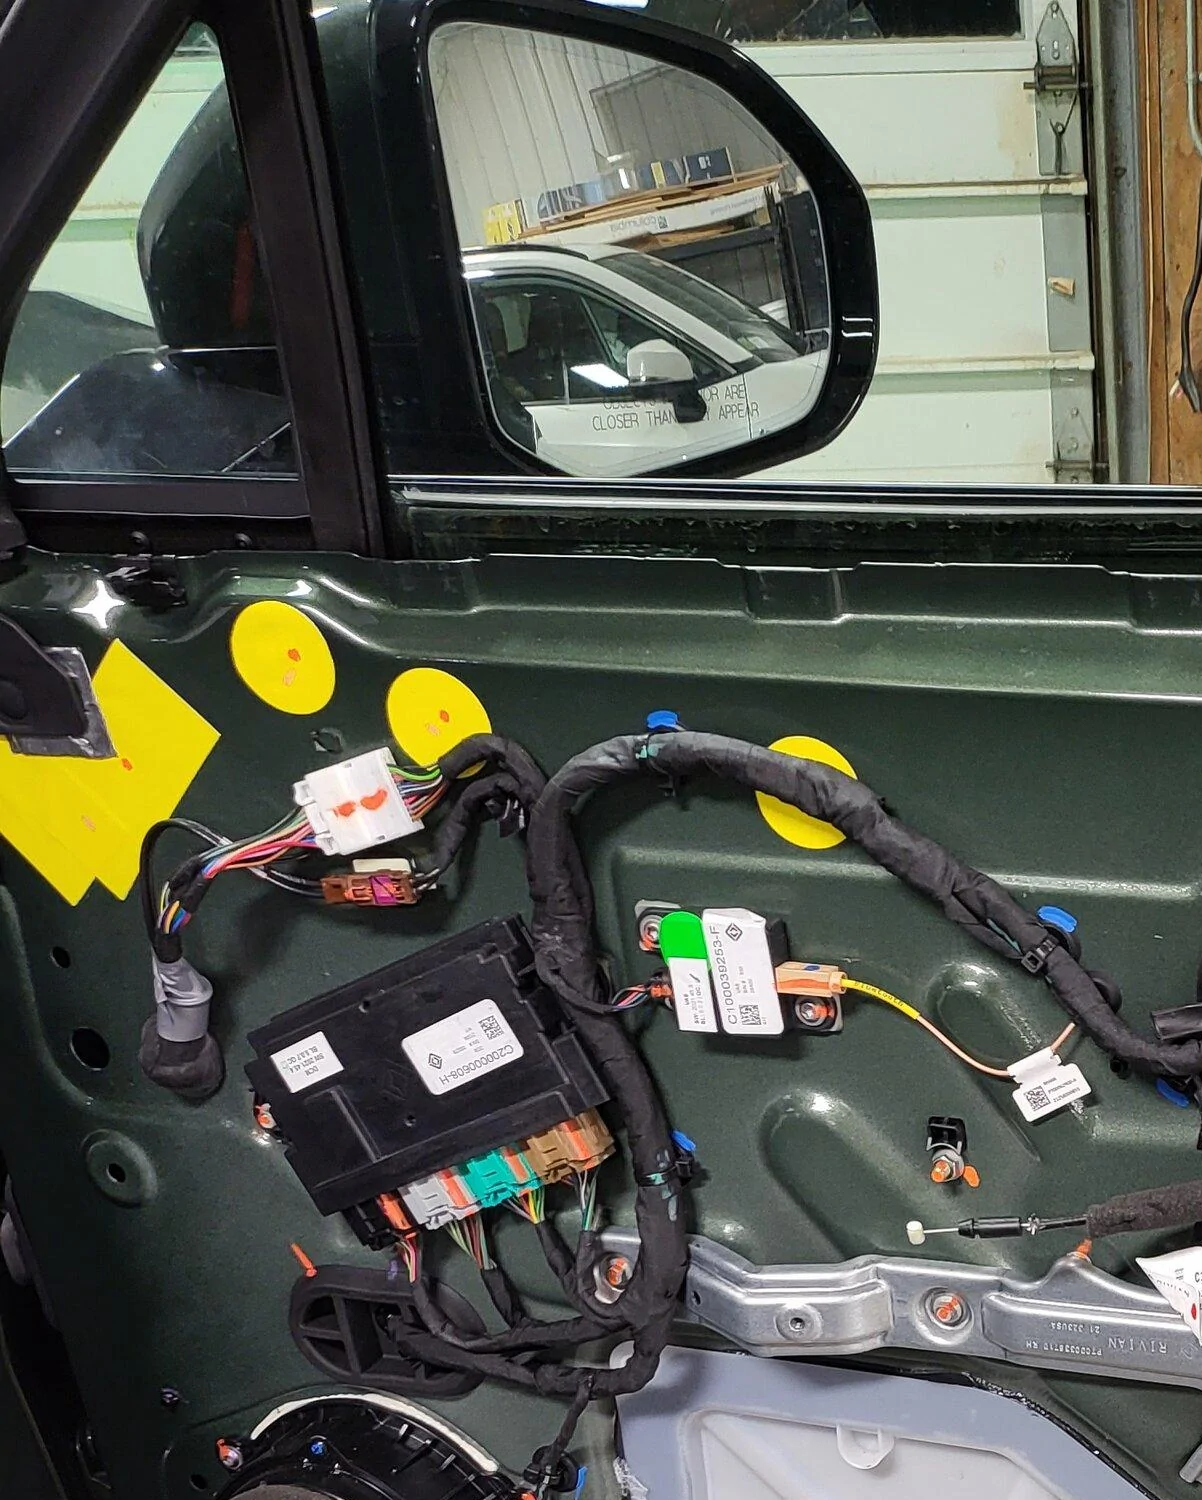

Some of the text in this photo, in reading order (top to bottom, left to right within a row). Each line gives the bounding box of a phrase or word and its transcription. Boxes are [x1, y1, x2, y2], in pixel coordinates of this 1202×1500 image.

[724, 383, 745, 400] ARE
[592, 411, 640, 431] CLOSER
[718, 401, 760, 420] APPEAR
[1108, 1336, 1169, 1355] RIVIAN
